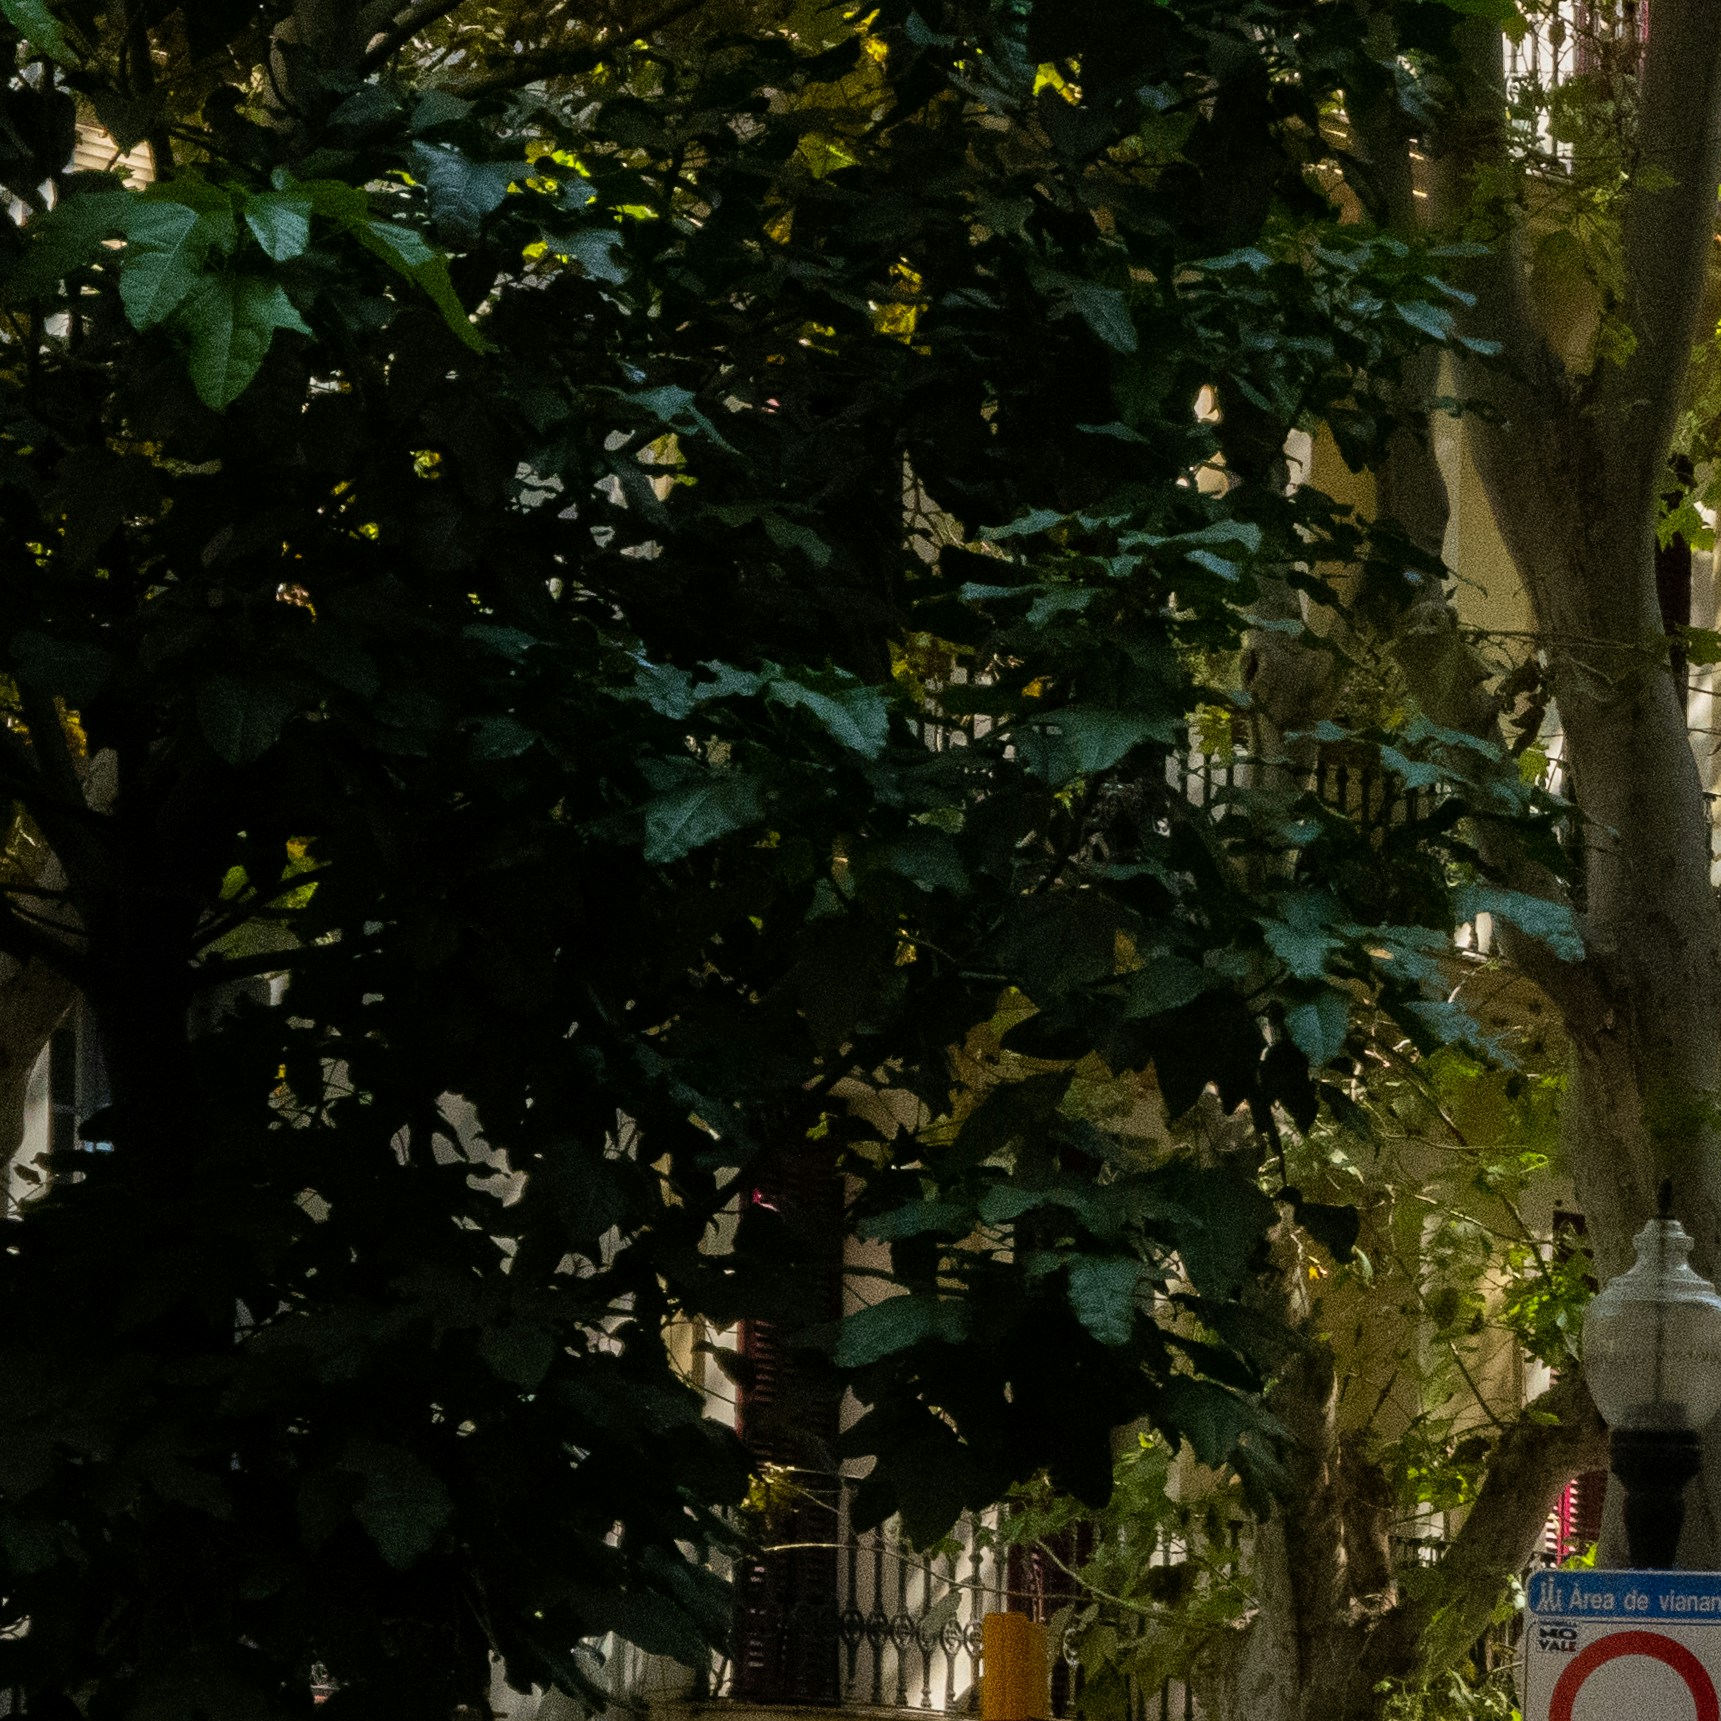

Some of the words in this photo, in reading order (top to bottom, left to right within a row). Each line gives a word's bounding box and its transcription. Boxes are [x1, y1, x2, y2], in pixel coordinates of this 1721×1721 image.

[1569, 1582, 1615, 1611] Àrea
[1623, 1589, 1649, 1611] de
[1539, 1640, 1577, 1652] VALE
